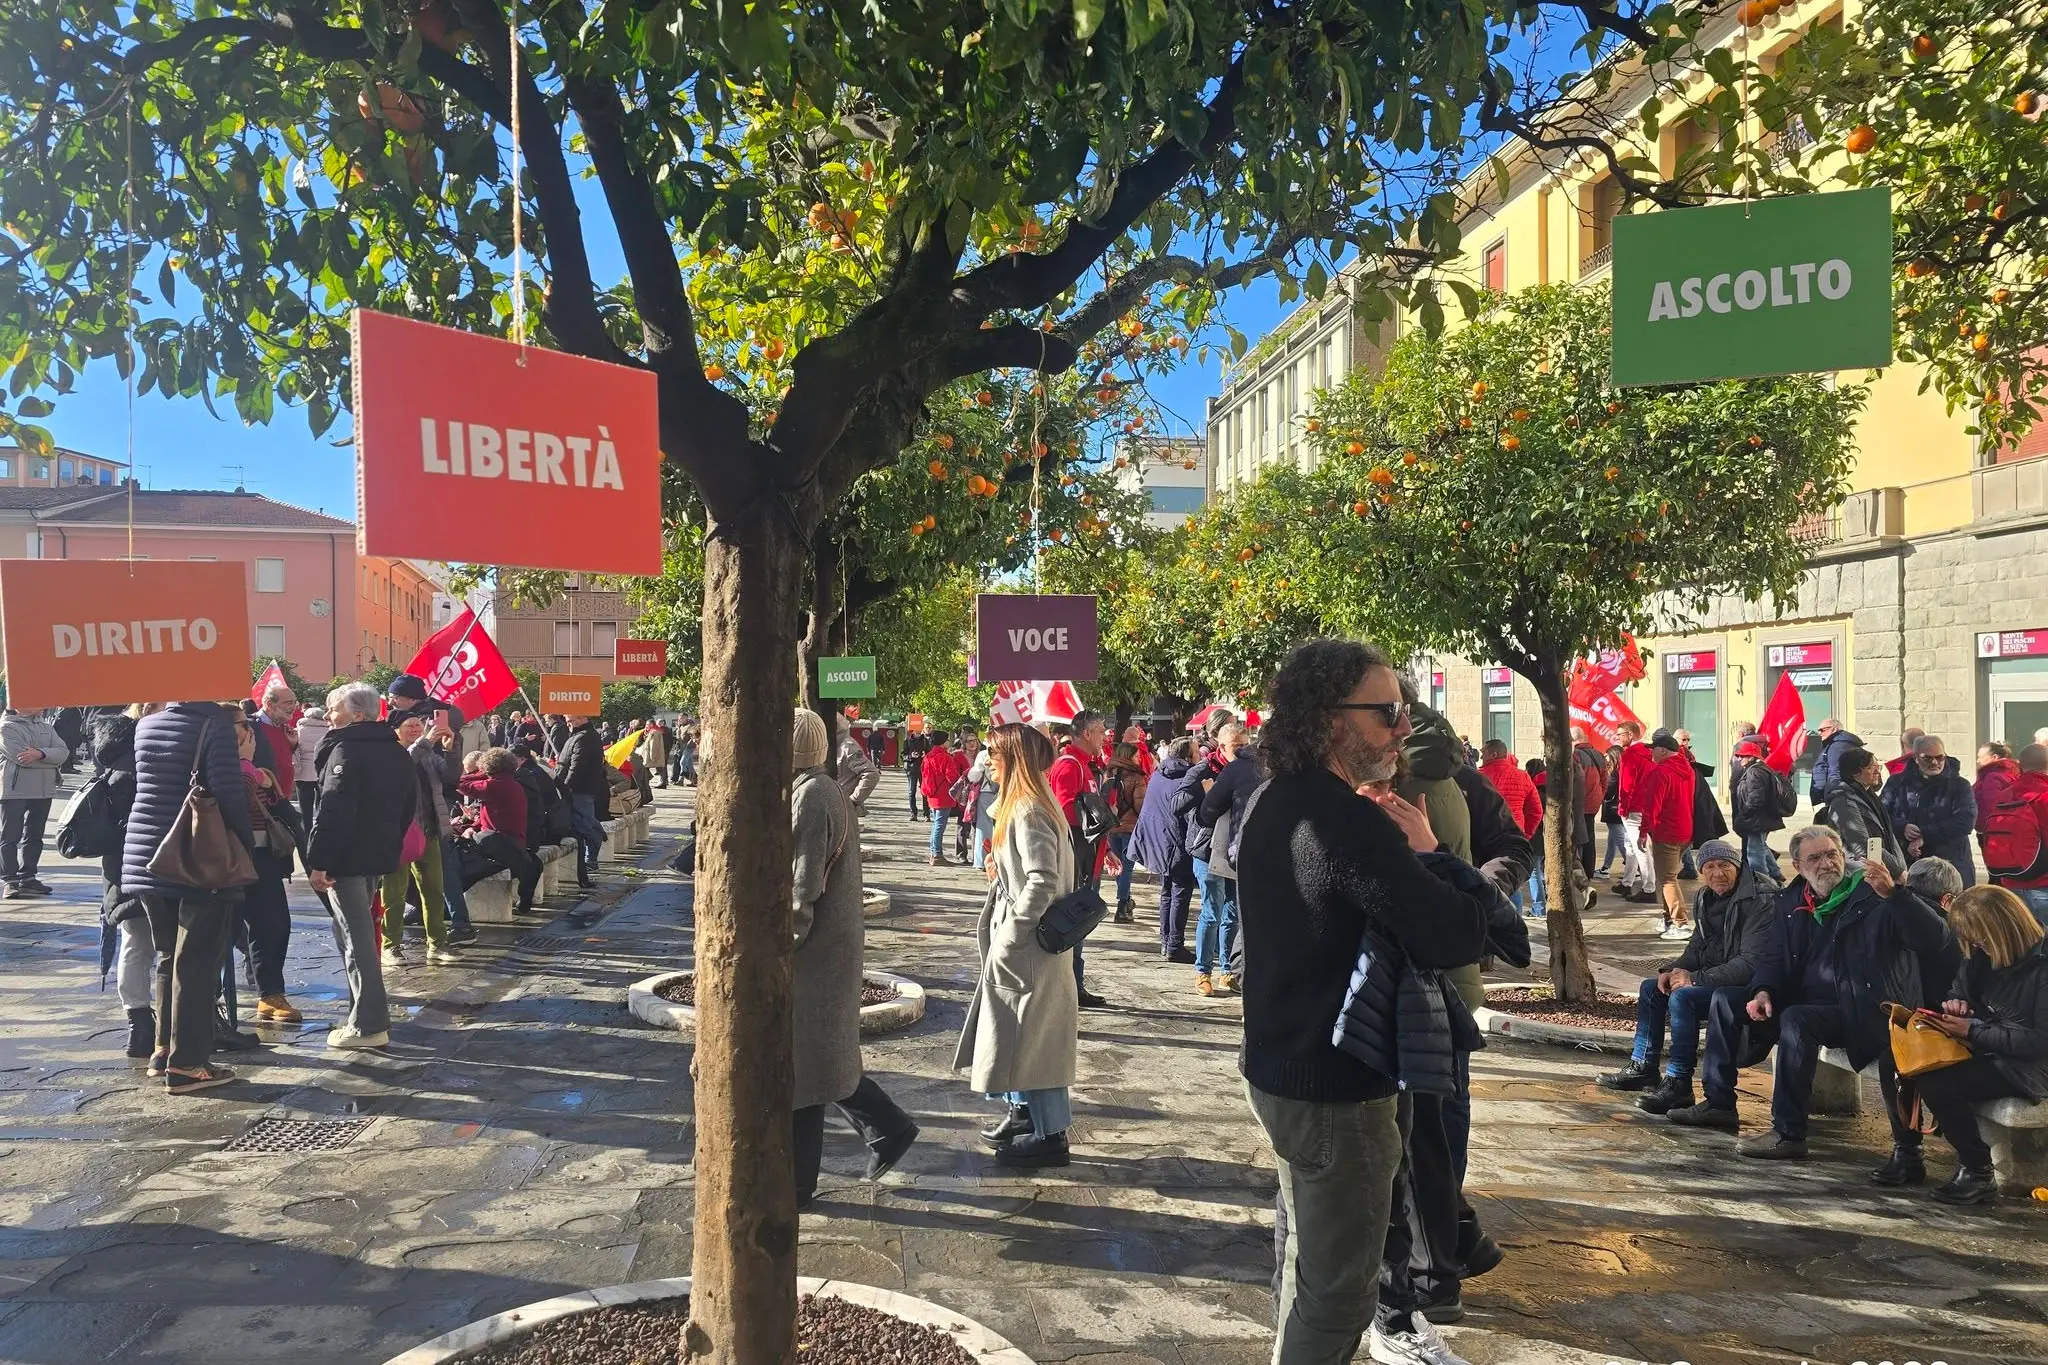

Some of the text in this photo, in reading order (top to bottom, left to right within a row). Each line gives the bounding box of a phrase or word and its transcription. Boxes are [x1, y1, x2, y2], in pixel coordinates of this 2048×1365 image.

[1648, 259, 1852, 322] ASCOLTO
[420, 418, 624, 491] LIBERTÀ
[52, 617, 217, 658] DIRITTO
[1007, 627, 1069, 652] VOCE
[622, 651, 658, 663] LIBERTÀ
[826, 670, 868, 683] ASCOLTO
[549, 691, 591, 703] DIRITTO
